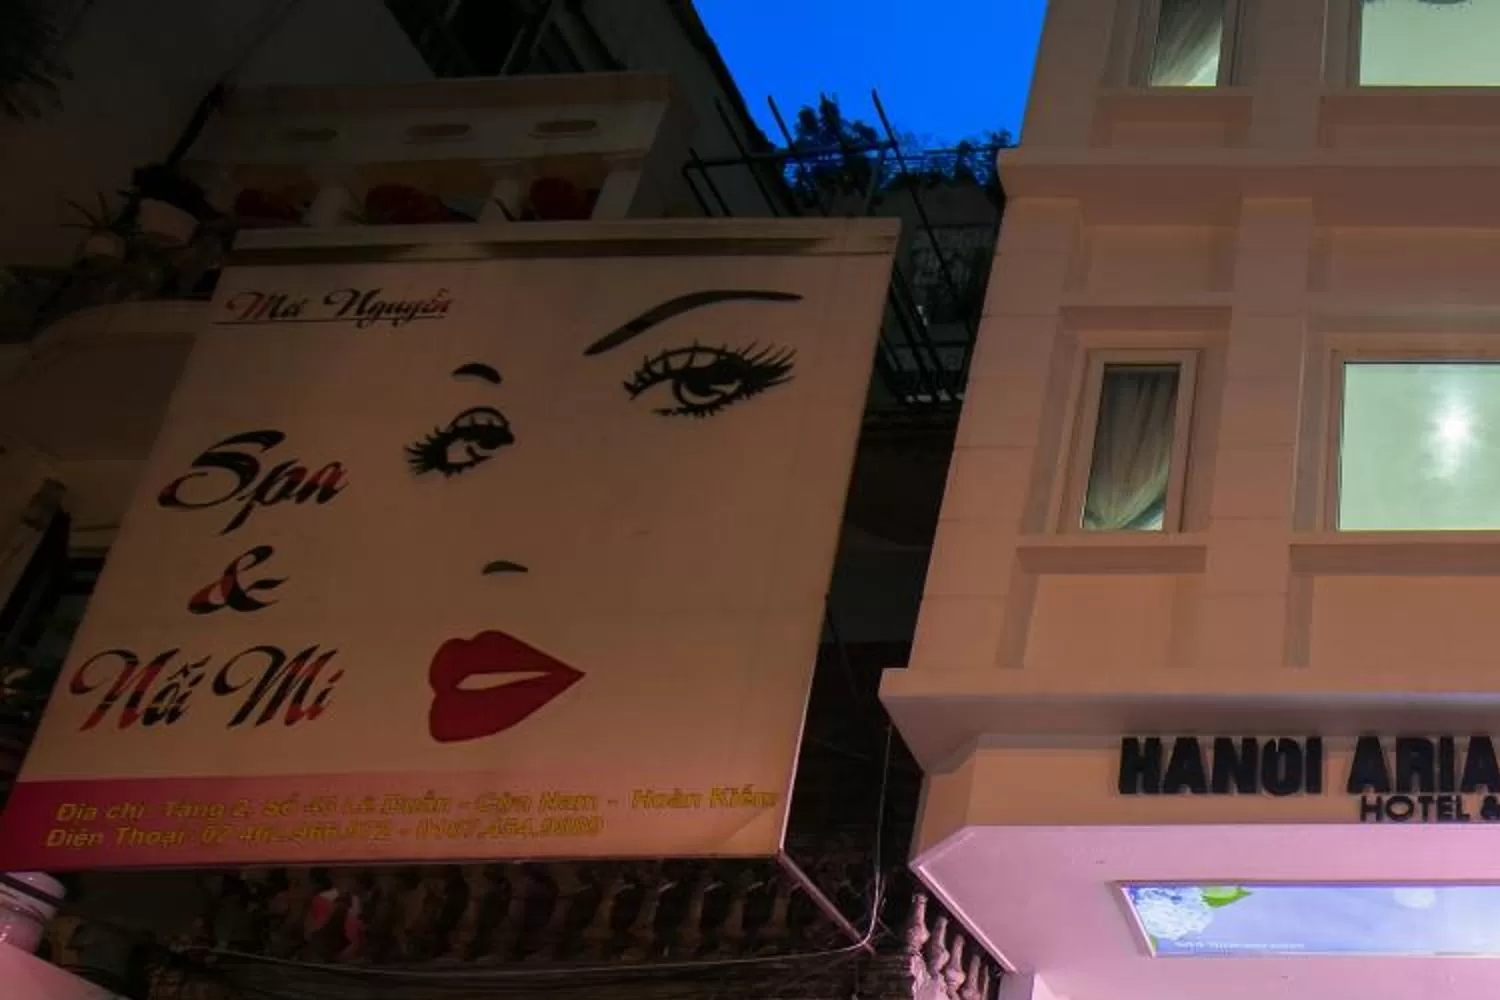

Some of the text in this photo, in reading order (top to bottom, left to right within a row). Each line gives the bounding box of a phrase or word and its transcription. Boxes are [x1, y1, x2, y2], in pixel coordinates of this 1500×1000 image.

[158, 430, 349, 534] Spa
[187, 545, 289, 614] &
[212, 644, 345, 731] Mi
[1118, 736, 1322, 797] HANOI
[1359, 795, 1471, 823] HOTEL
